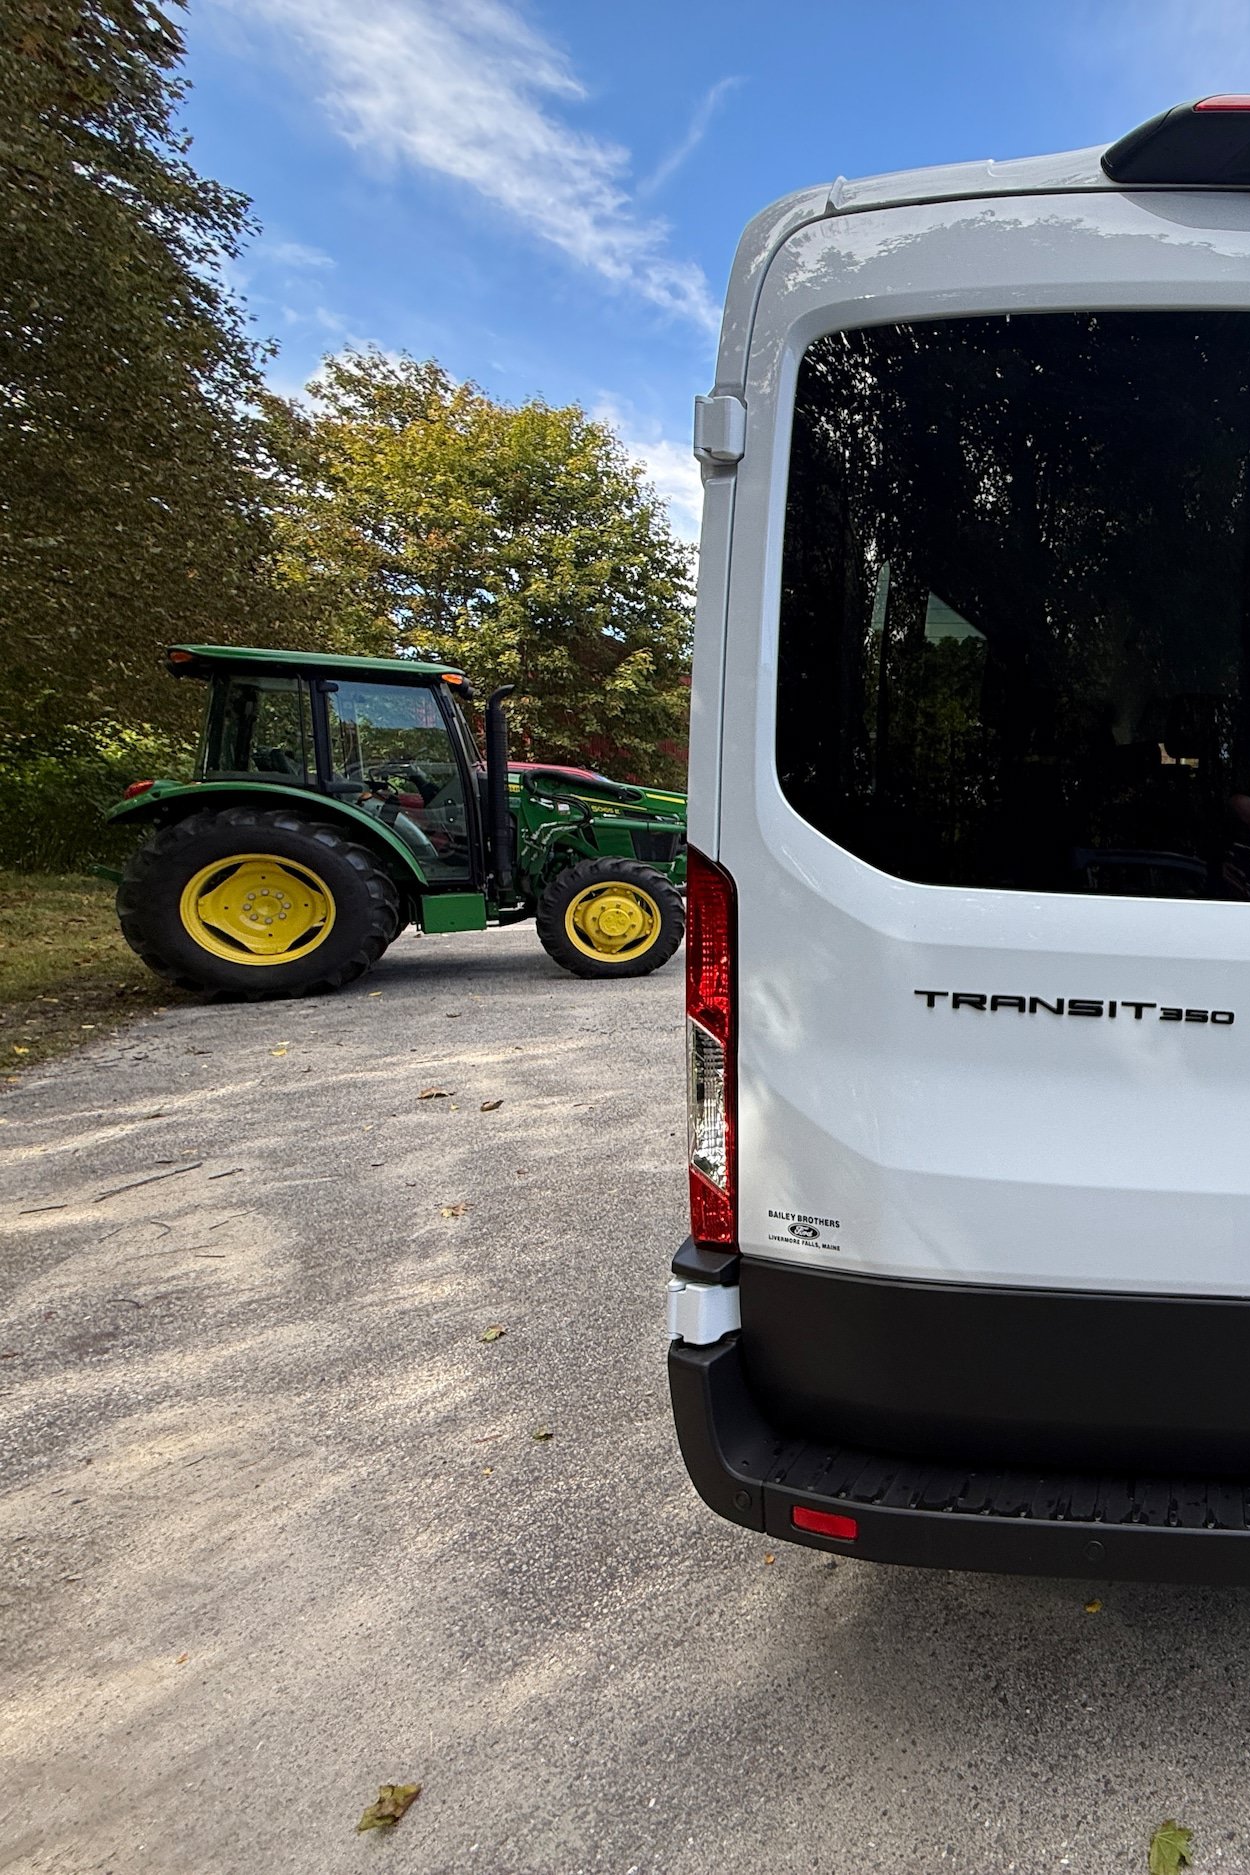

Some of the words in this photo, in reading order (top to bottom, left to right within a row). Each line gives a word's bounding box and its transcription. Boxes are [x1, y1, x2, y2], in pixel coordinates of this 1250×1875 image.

[768, 1210, 796, 1221] BAILEY
[797, 1214, 841, 1228] BROTHERS
[794, 1225, 813, 1237] Ford
[768, 1234, 800, 1245] LIVERMORE
